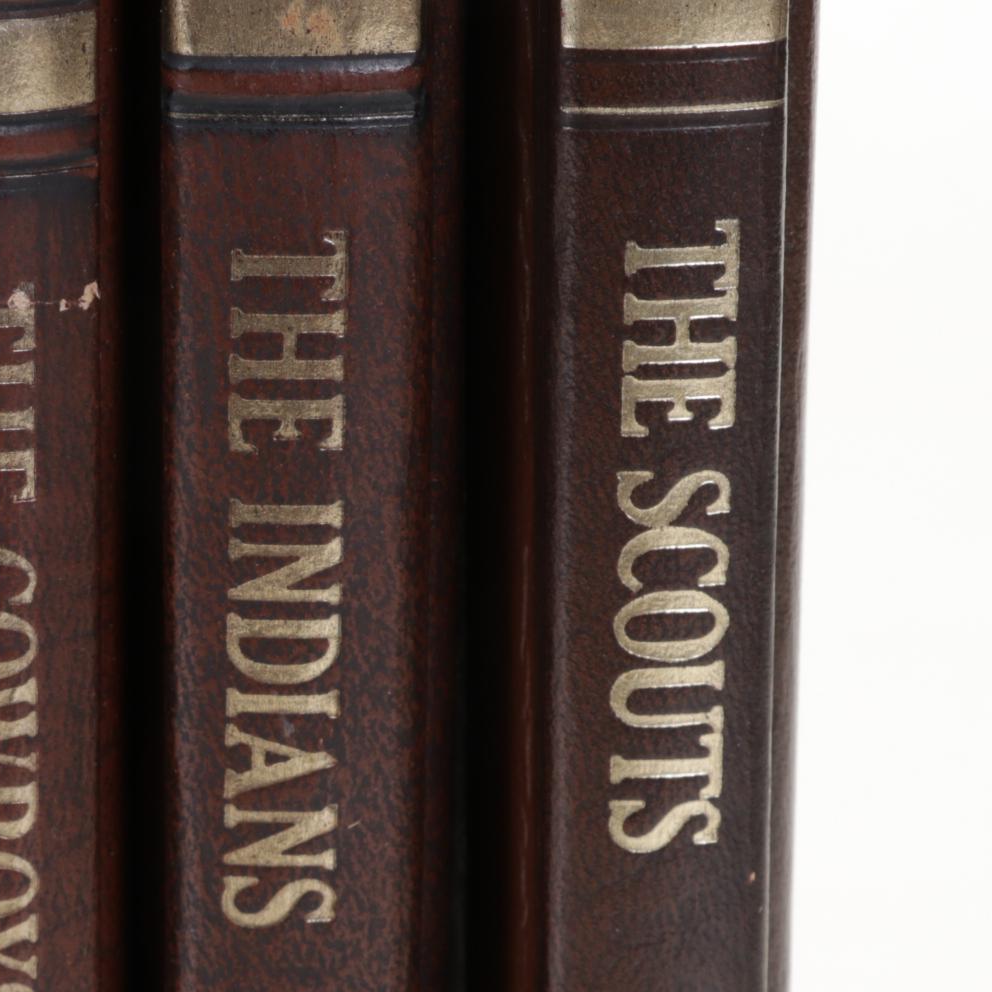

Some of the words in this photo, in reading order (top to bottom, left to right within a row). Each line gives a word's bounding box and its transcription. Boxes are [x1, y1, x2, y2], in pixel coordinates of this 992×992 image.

[227, 230, 347, 451] THE
[619, 218, 740, 435] THE
[221, 500, 344, 928] INDIANS
[608, 469, 731, 854] SCOUTS
